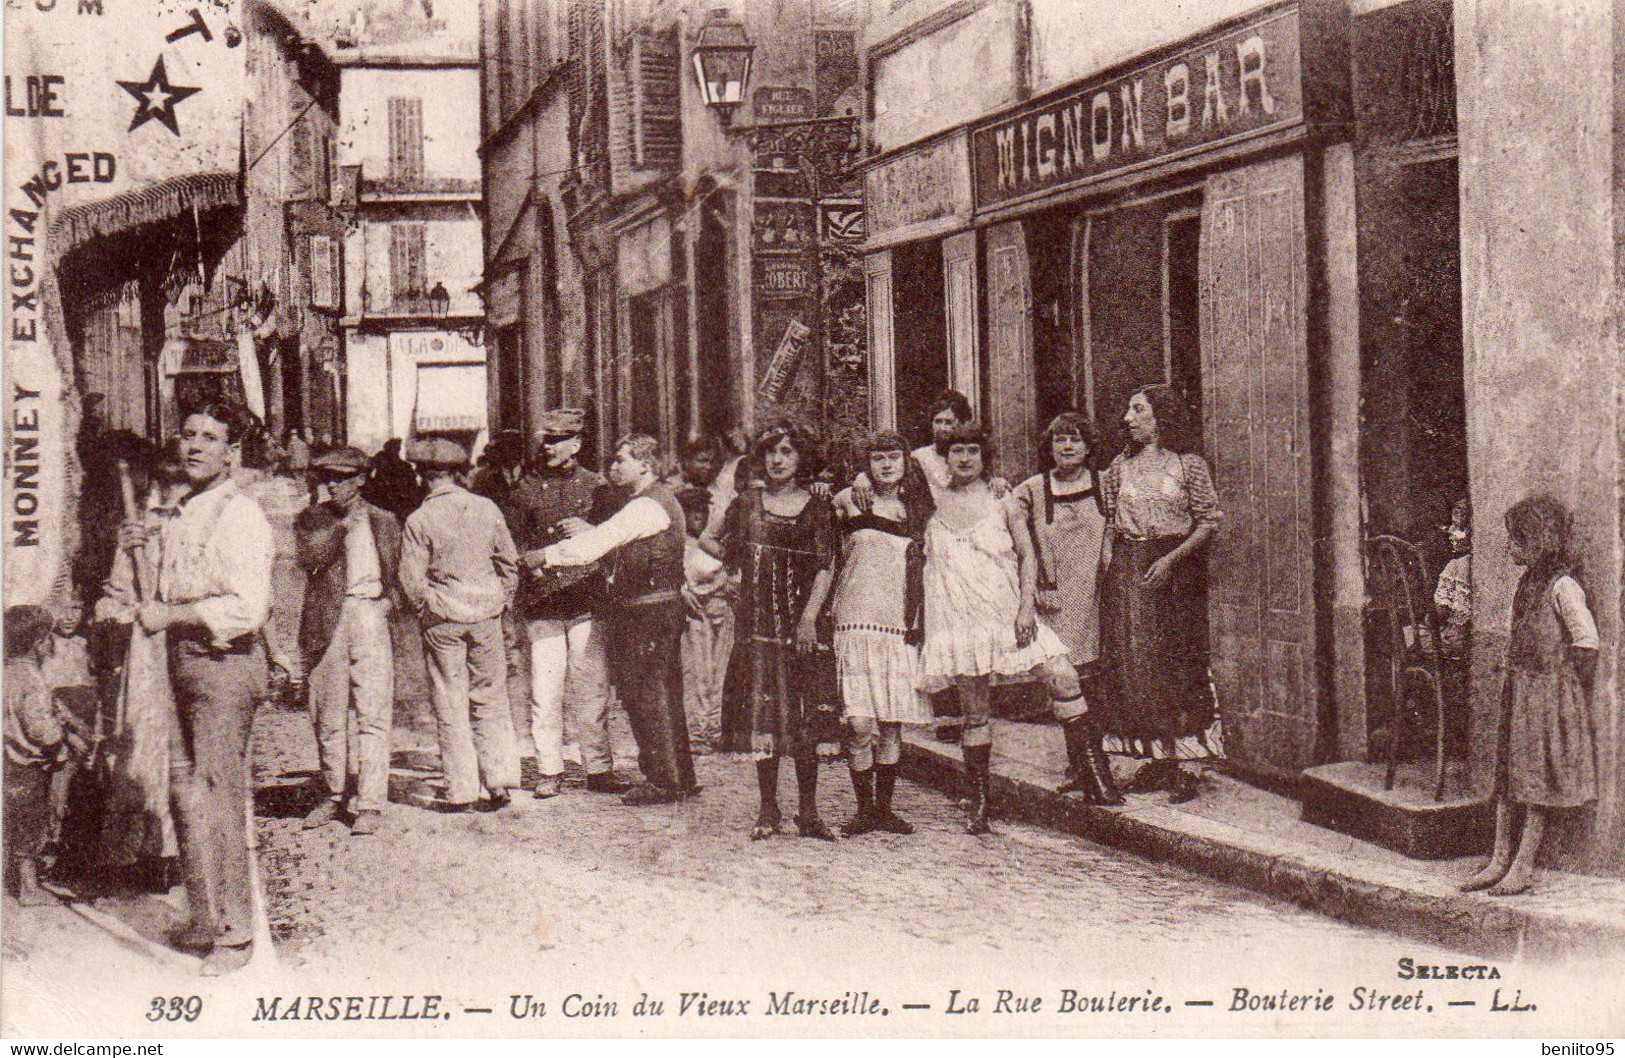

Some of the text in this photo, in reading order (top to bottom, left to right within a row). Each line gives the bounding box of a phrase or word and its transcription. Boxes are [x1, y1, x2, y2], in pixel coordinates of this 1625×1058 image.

[996, 35, 1275, 191] MIGNON BAR
[9, 152, 116, 547] MONNEY EXCHANGED
[146, 996, 202, 1022] 339
[252, 996, 450, 1021] MARSEILLE.
[510, 995, 546, 1019] Un
[562, 993, 617, 1018] Coin
[633, 993, 664, 1016] du
[680, 992, 749, 1016] Vieux
[765, 991, 889, 1016] Marseille.
[946, 990, 980, 1014] La
[993, 990, 1042, 1014] Rue
[1057, 989, 1172, 1014] Bouterie.
[1229, 987, 1334, 1011] Bouterie
[1349, 986, 1433, 1013] Street.
[1490, 988, 1537, 1012] LL.
[1398, 958, 1501, 980] SELECTA
